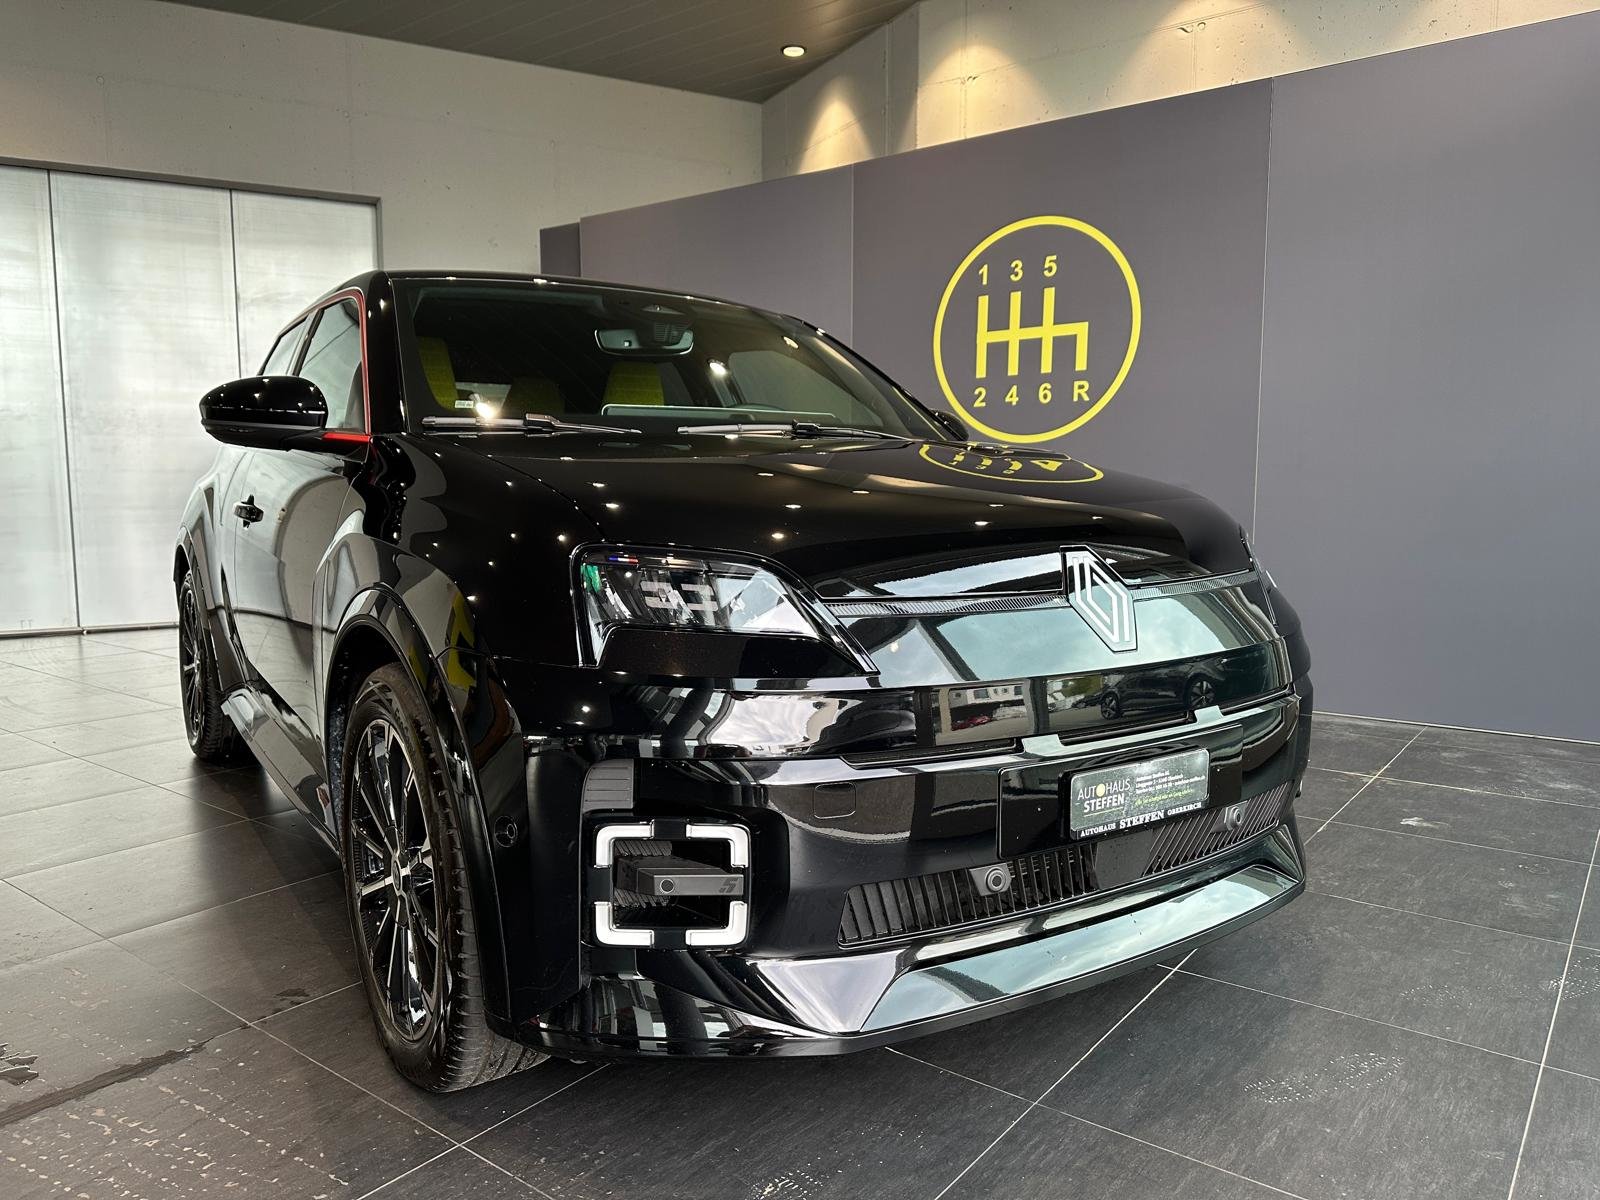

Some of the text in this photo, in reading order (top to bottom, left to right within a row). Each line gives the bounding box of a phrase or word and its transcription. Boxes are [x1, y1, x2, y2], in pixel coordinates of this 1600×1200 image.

[978, 254, 1057, 285] 1 3 5
[973, 380, 1090, 407] 2 4 6 R
[1077, 778, 1130, 801] AUTOHAUS
[1083, 792, 1125, 813] STEFFEN
[1080, 801, 1202, 838] AUTOHAUS STEFFEN OBERKIRCH
